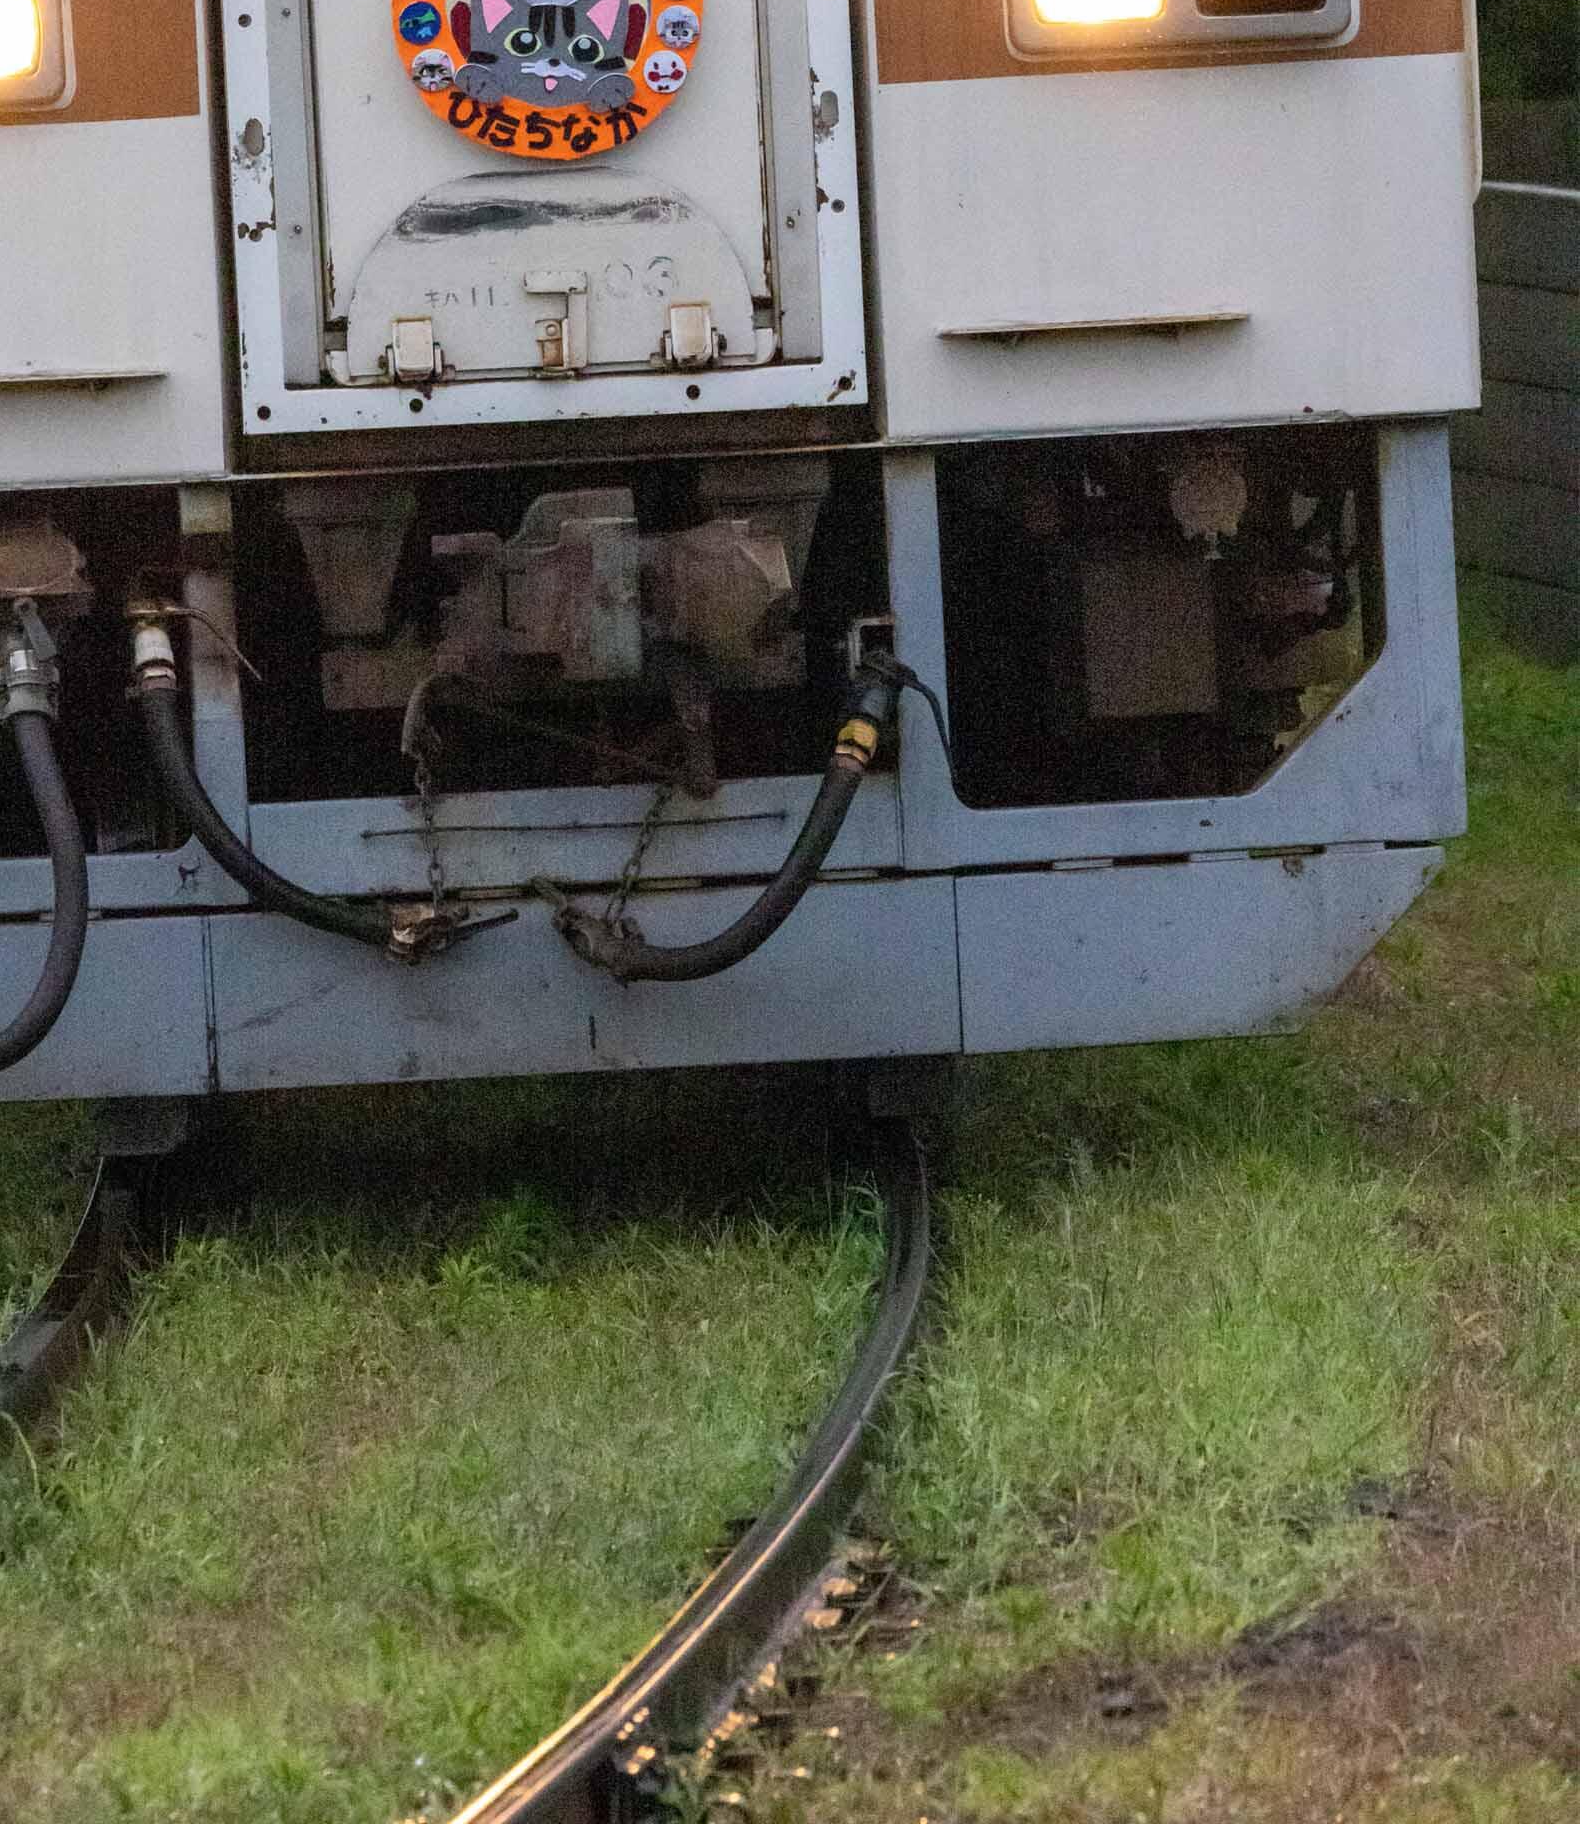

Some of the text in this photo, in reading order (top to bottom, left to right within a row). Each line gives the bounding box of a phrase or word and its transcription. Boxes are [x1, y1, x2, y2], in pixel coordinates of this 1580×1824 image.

[447, 91, 648, 153] ひたちなか
